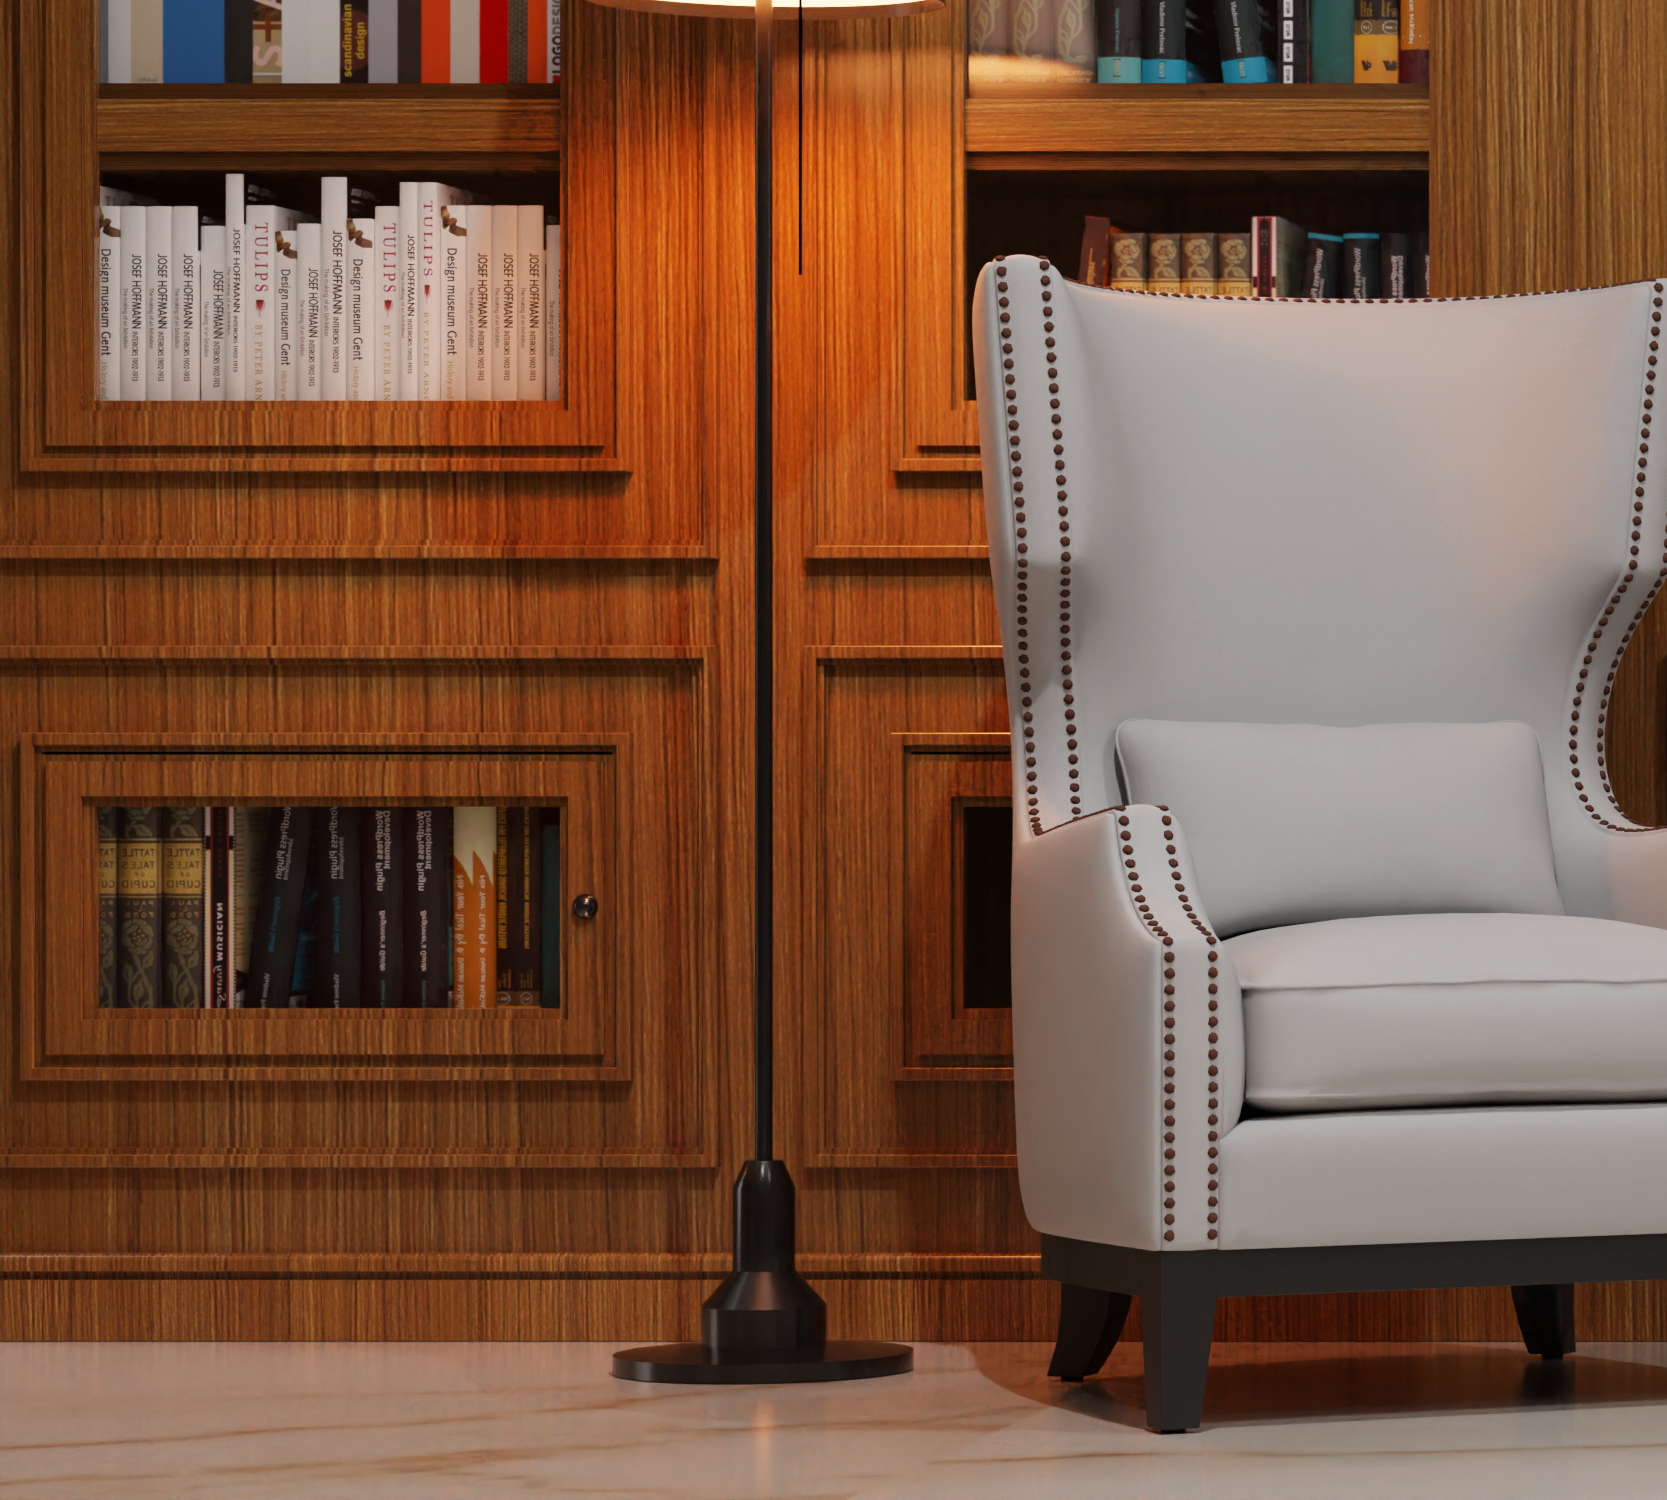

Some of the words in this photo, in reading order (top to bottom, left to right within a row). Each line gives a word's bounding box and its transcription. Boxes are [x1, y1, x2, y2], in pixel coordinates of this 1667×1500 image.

[342, 2, 354, 79] scandinavian
[354, 20, 367, 61] design
[351, 259, 363, 291] Design
[384, 223, 396, 292] TULIPS
[353, 338, 363, 360] Gent
